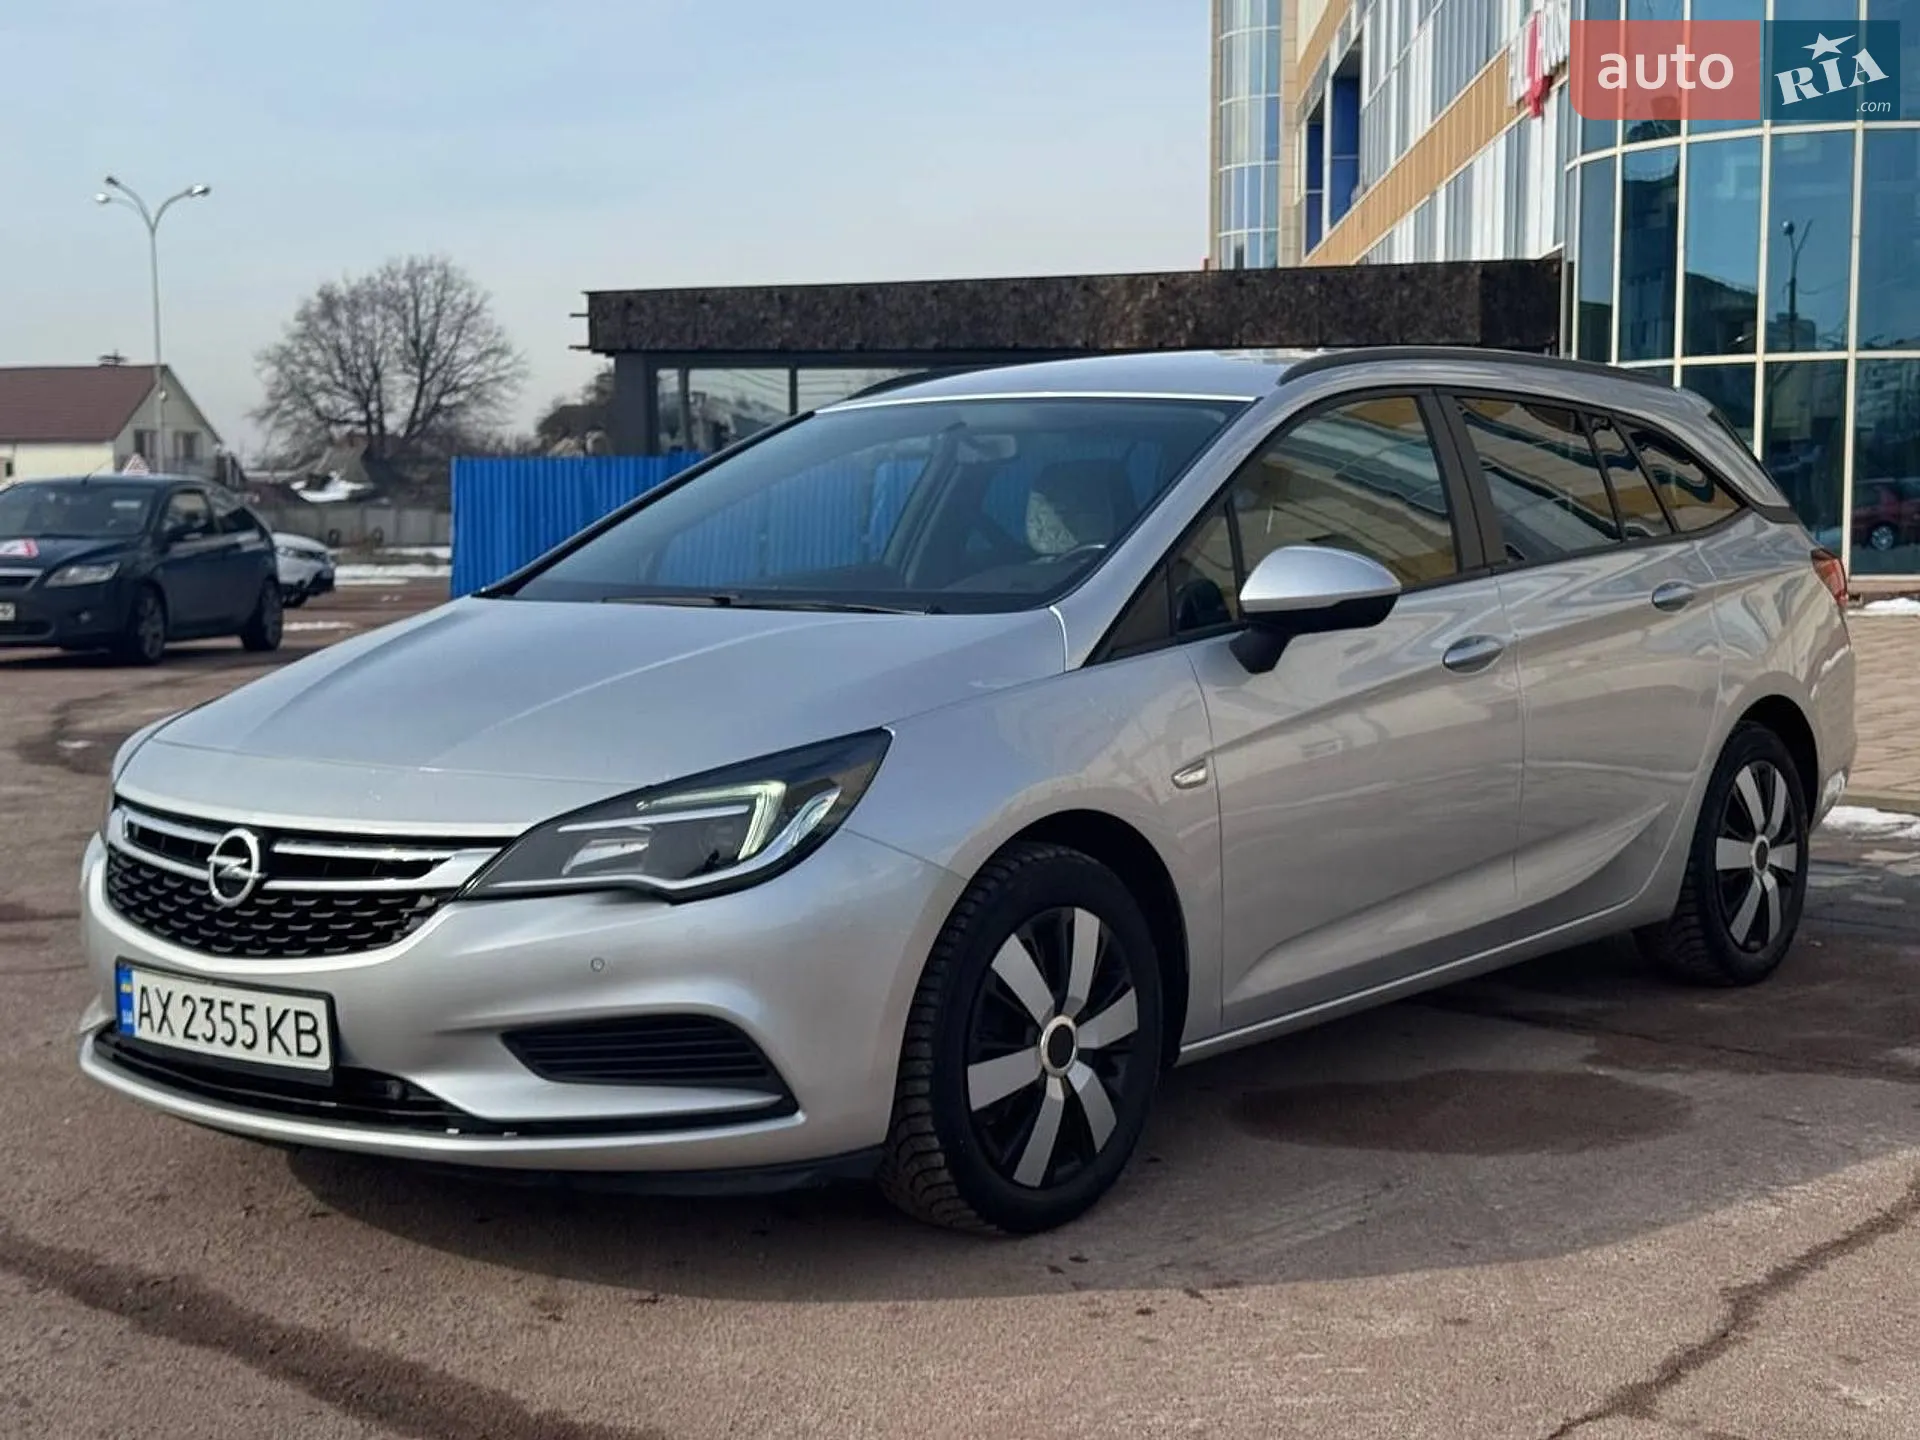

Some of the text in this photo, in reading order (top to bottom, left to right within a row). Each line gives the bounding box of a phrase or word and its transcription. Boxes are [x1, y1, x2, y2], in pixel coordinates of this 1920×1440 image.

[138, 985, 322, 1058] AX 2355 KB
